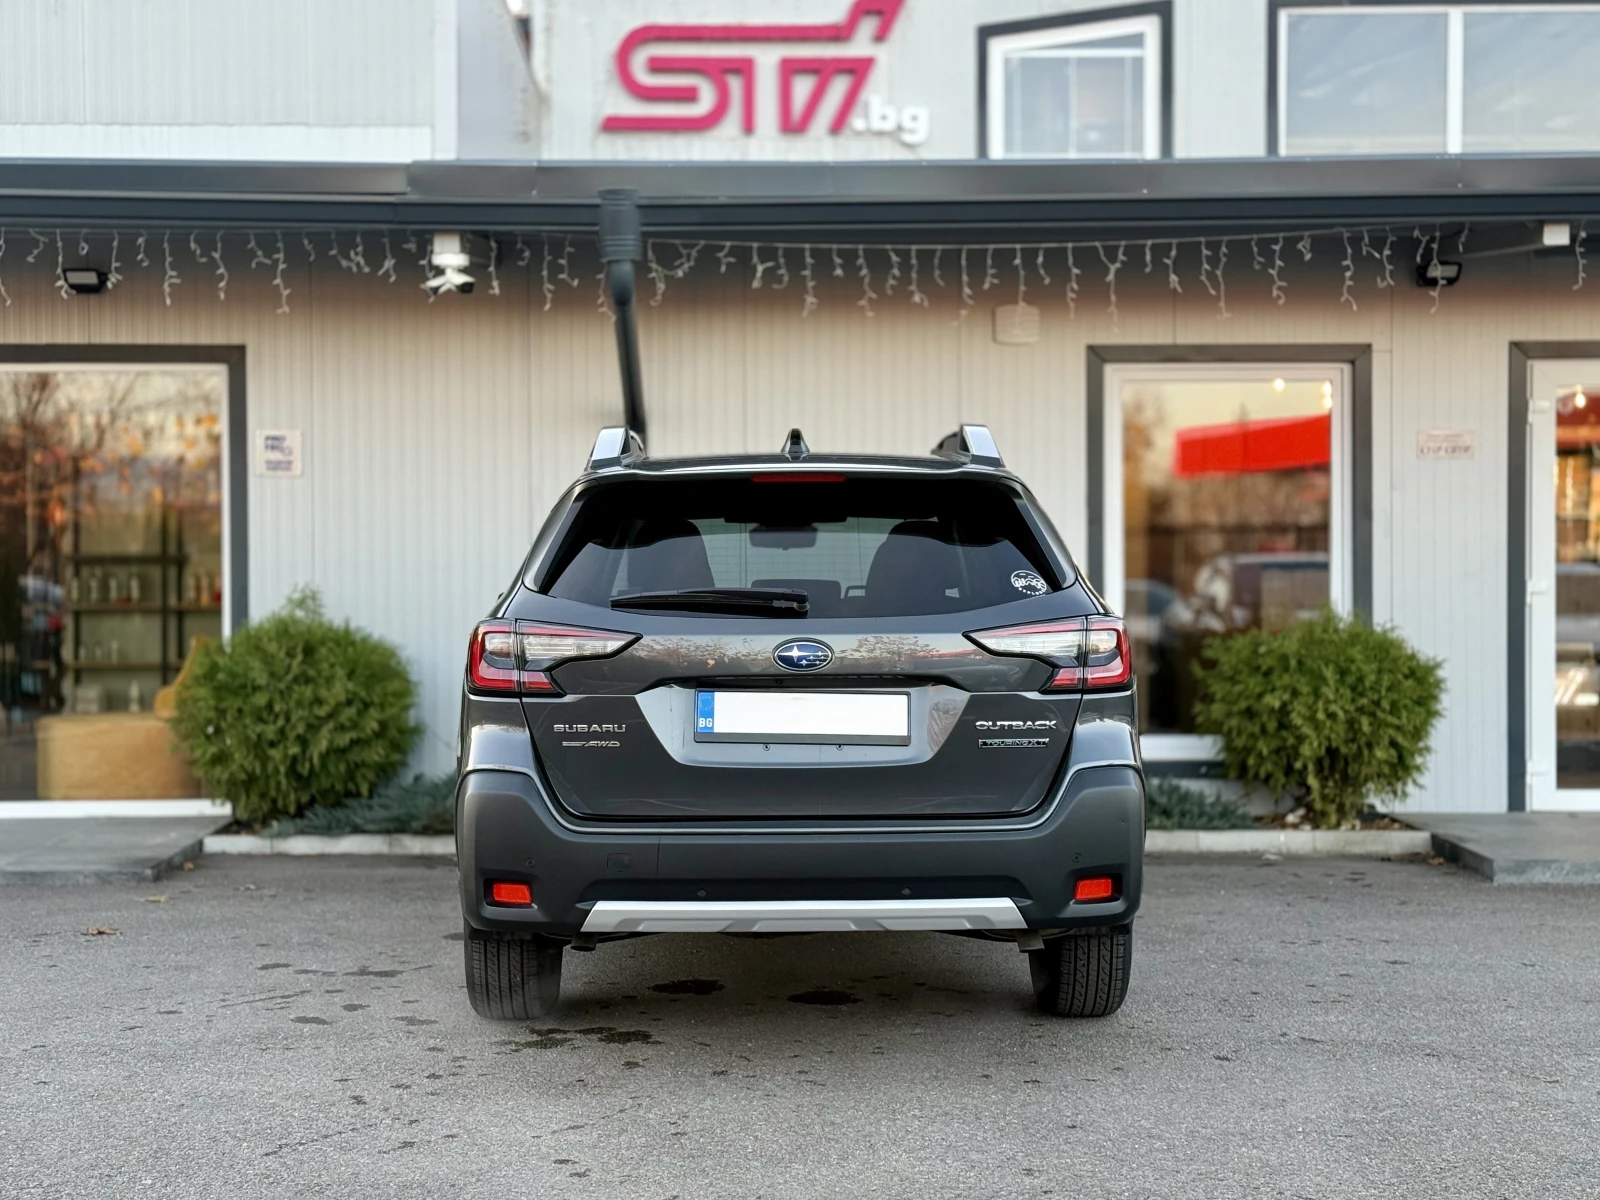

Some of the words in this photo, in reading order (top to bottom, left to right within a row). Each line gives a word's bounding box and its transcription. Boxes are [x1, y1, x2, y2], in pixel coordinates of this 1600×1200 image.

[699, 717, 713, 728] BG
[975, 720, 1057, 730] OUTBACK
[553, 724, 626, 733] SUBARU
